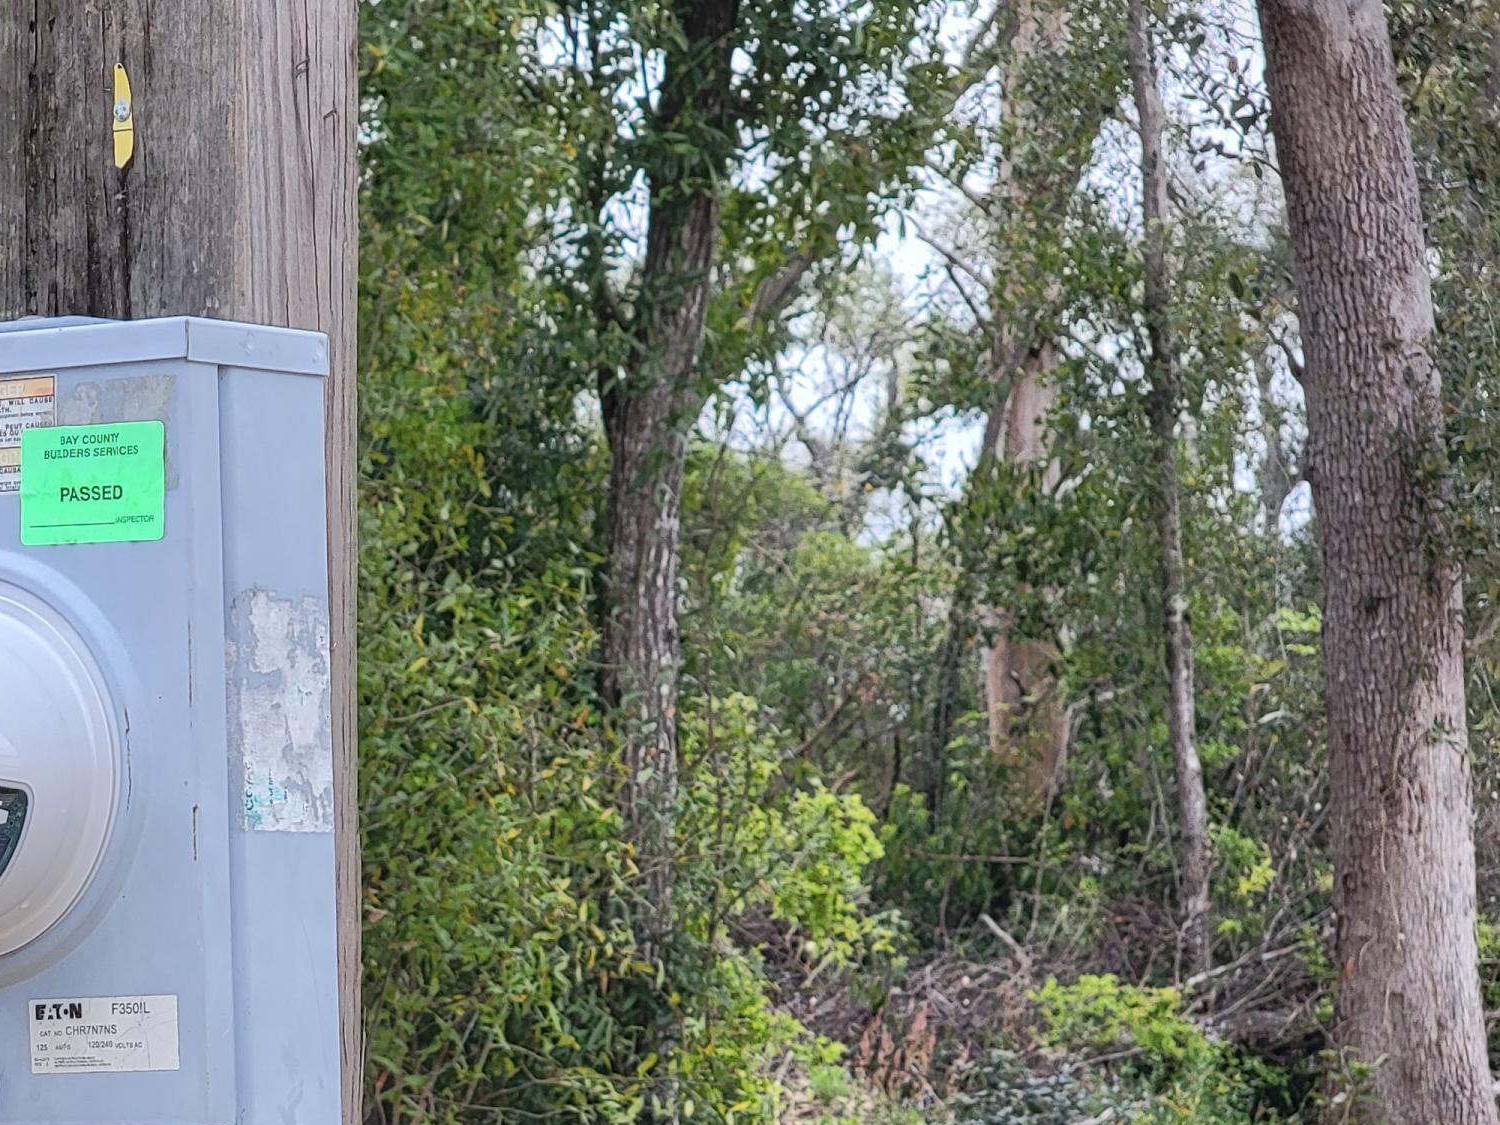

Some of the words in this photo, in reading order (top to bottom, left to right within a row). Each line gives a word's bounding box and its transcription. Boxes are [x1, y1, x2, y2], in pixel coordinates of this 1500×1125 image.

[29, 397, 52, 405] CAUSE
[60, 435, 81, 445] BAY
[82, 433, 120, 444] COUNTY
[44, 448, 91, 459] BUILDERS
[93, 445, 139, 457] SERVICES
[60, 485, 123, 502] PASSED
[115, 515, 155, 524] INSPECTOR
[65, 1024, 117, 1036] CHR7N7NS
